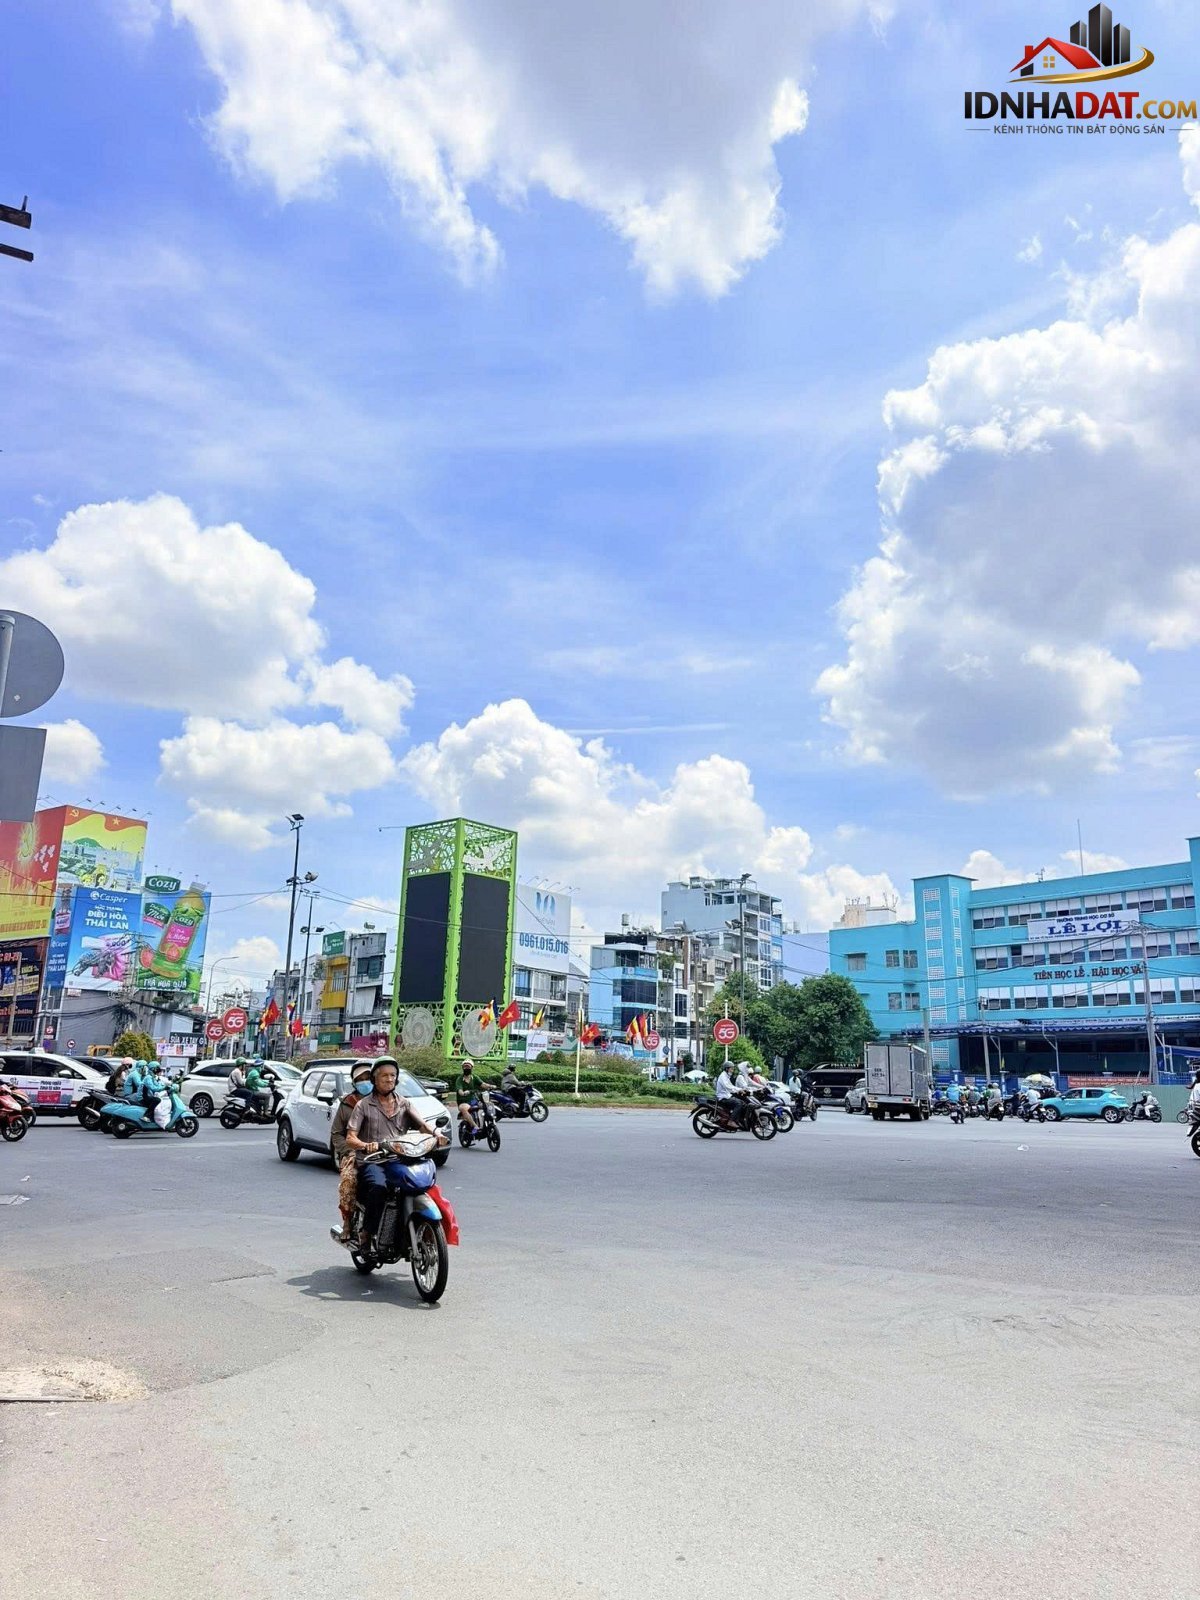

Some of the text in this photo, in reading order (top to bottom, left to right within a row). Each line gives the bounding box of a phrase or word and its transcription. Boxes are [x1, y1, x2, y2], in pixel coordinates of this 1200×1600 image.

[149, 878, 177, 890] Cozy
[100, 893, 128, 904] Casper
[85, 917, 129, 930] THÁI LAN
[1047, 922, 1076, 935] LÊ
[1081, 919, 1122, 933] LỢI
[519, 932, 569, 954] 0961.015.016
[1054, 969, 1072, 980] HỌC
[1112, 966, 1130, 978] HỌC
[227, 1016, 244, 1028] 5G
[209, 1026, 223, 1036] 5G
[719, 1027, 734, 1039] 5G
[182, 1036, 189, 1044] XE
